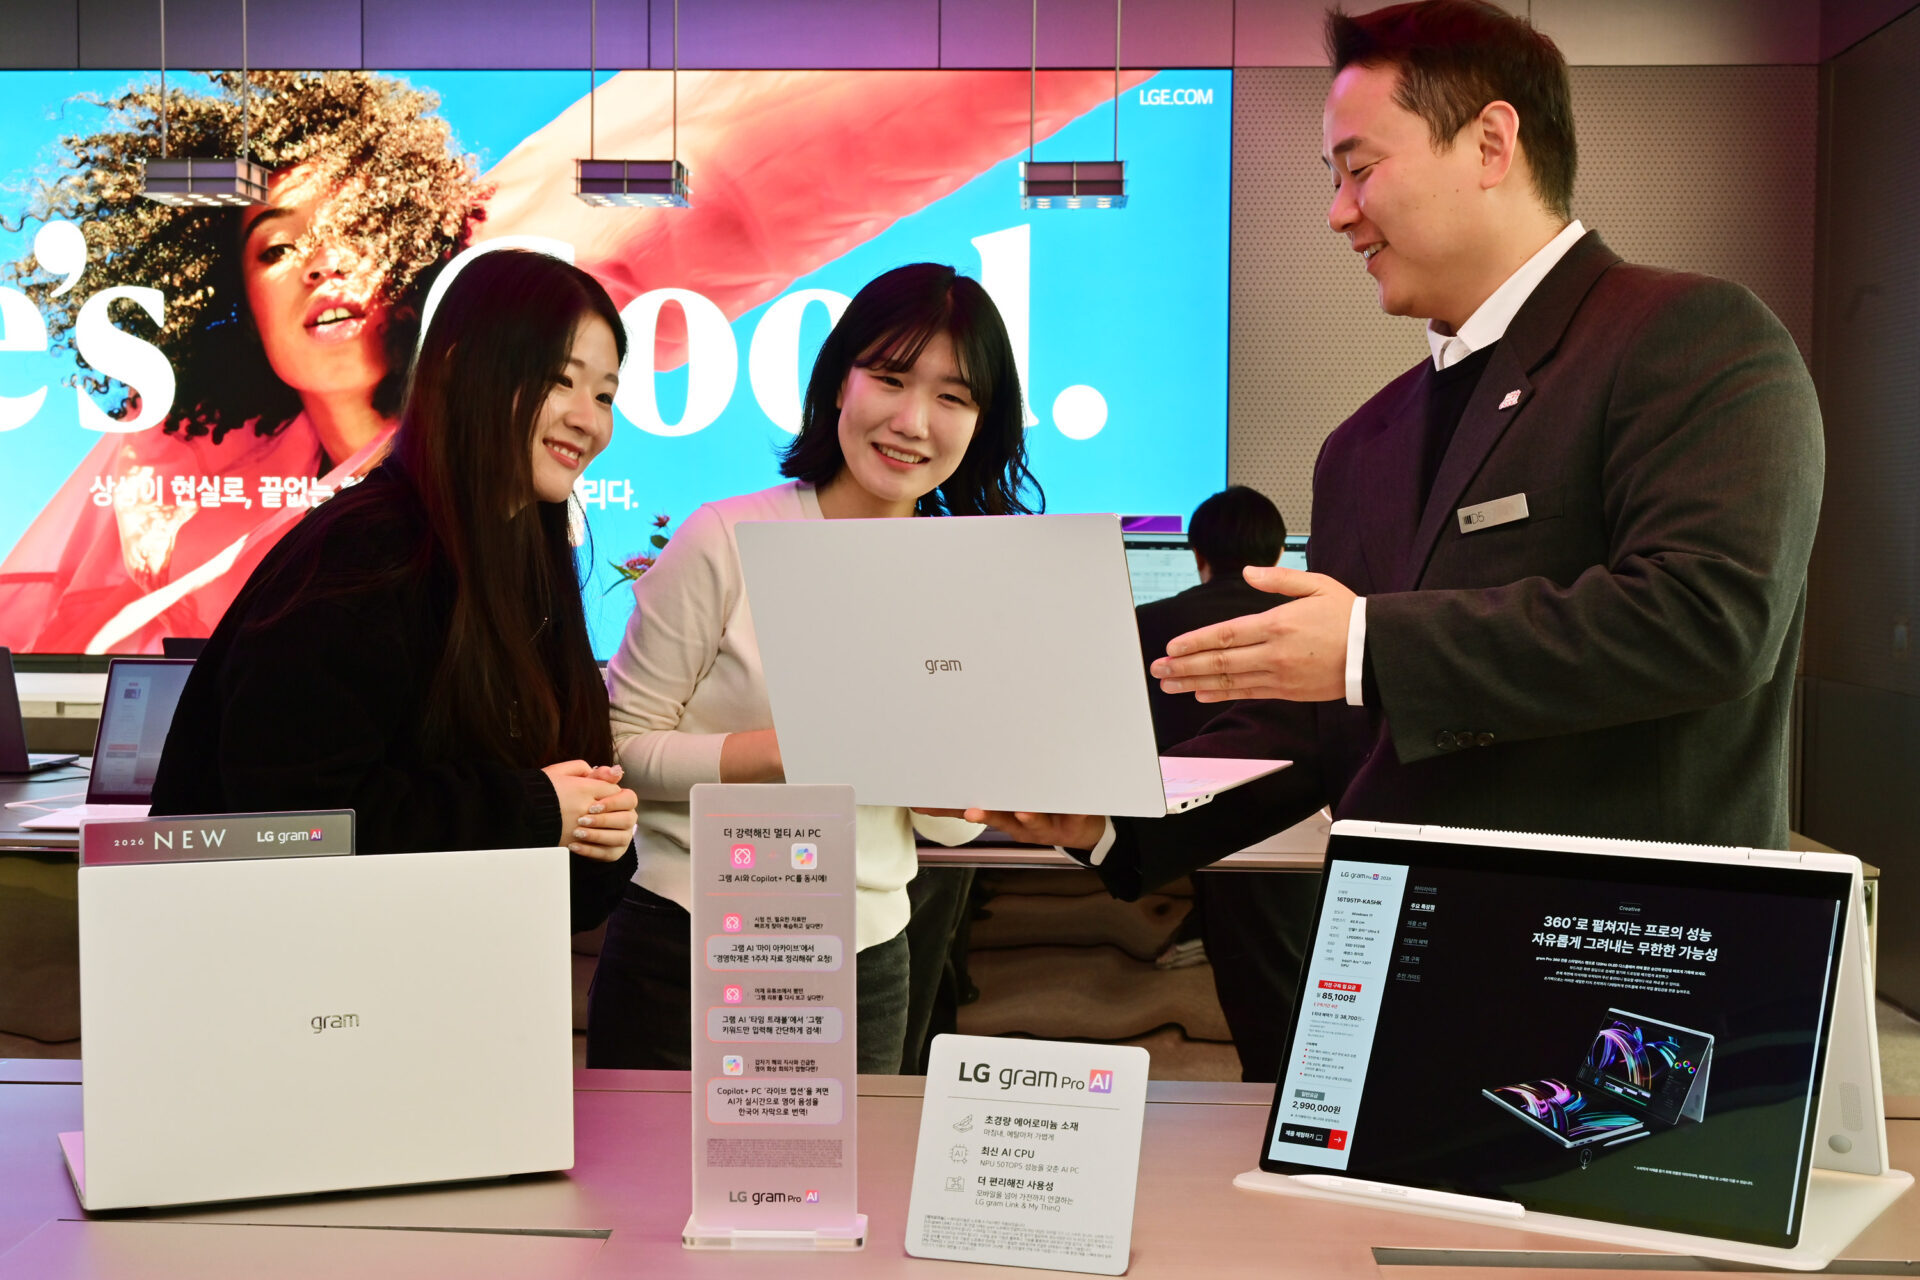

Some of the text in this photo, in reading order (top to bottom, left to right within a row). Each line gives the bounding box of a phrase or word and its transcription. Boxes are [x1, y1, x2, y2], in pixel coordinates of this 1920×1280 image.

[1140, 88, 1214, 105] LGE.COM
[170, 476, 252, 510] 현실로,
[925, 659, 962, 675] gram
[114, 829, 321, 850] 2026 NEW LG gram AI
[723, 828, 821, 838] 더 강력해진 멀티 AI PC
[718, 875, 732, 883] 그램
[751, 875, 783, 884] Copilot+
[1619, 905, 1641, 913] Creative
[1592, 919, 1642, 936] 펼쳐지는
[1644, 923, 1683, 940] 프로의
[1686, 928, 1712, 943] 성능
[1531, 932, 1718, 962] 자유롭게 그려내는 무한한 가능성
[1322, 992, 1356, 1003] 85,100원
[311, 1014, 359, 1034] gram
[959, 1062, 1109, 1090] LG gram Pro AI
[717, 1087, 748, 1096] Copilot+
[1292, 1101, 1341, 1114] 2,990,000원
[985, 1115, 1079, 1131] 초경량 에어로미늄 소재
[981, 1146, 1035, 1158] 최신 AI CPU
[980, 1159, 995, 1167] NPU
[977, 1176, 1054, 1192] 더 편리해진 사용성
[729, 1191, 818, 1205] LG gram Pro AI
[975, 1198, 985, 1206] LG
[1005, 1200, 1019, 1209] Link
[1028, 1203, 1038, 1211] My
[1041, 1203, 1061, 1213] ThinQ
